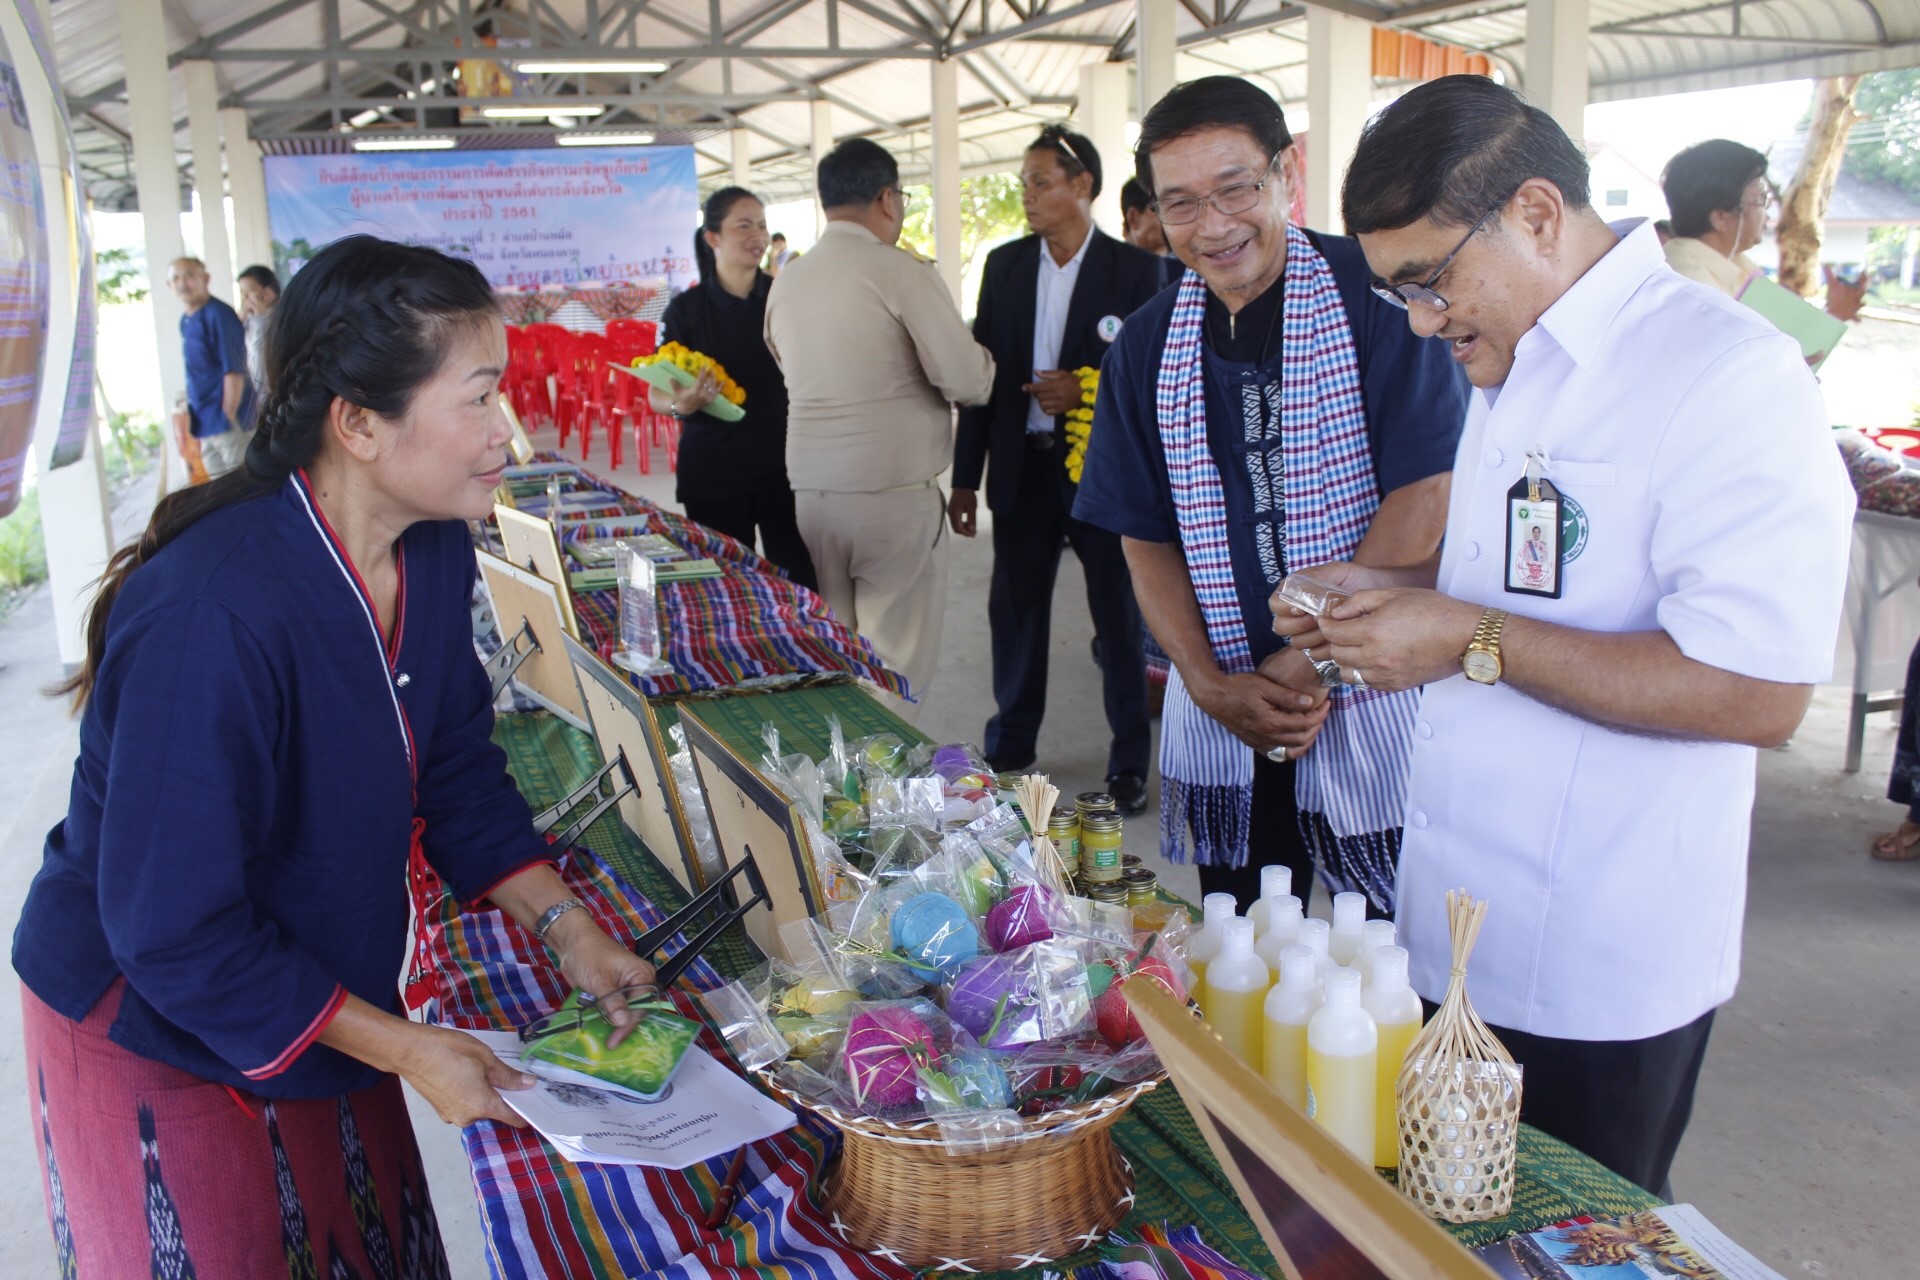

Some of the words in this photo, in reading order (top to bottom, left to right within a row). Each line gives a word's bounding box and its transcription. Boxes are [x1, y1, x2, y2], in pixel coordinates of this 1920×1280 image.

[443, 203, 493, 220] ประจำปี
[501, 206, 537, 218] 2561
